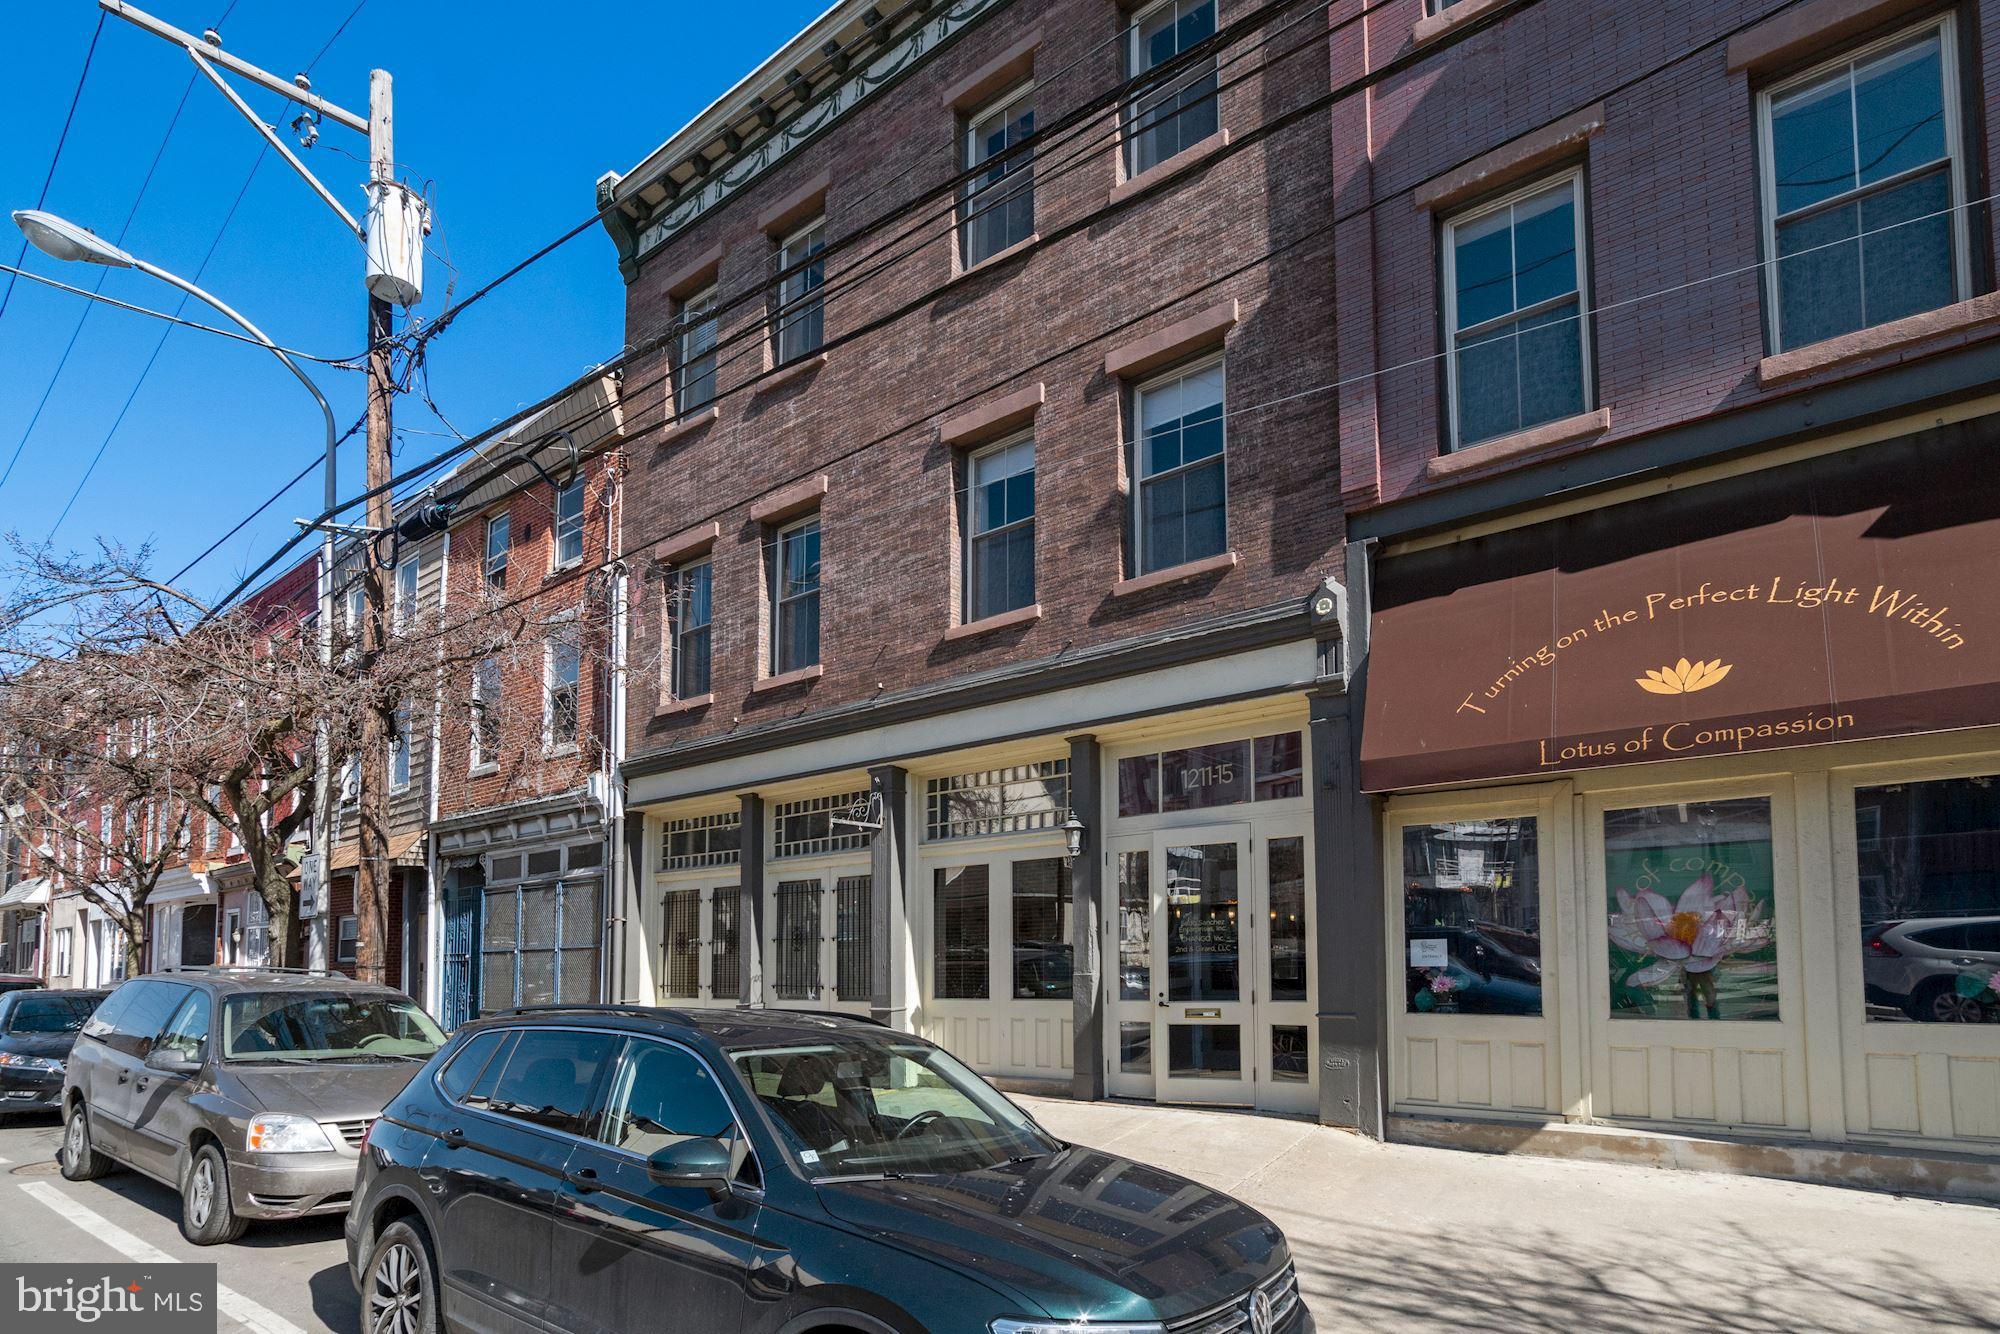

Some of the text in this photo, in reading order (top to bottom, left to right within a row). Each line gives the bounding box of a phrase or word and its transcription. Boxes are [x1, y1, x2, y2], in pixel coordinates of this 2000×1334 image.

[1457, 576, 1964, 714] Turning on the Perfect Light Within
[1540, 712, 1854, 766] Lotus of Compassion
[1181, 763, 1234, 789] 1211-15
[304, 859, 317, 874] ONE
[303, 876, 318, 891] WAY
